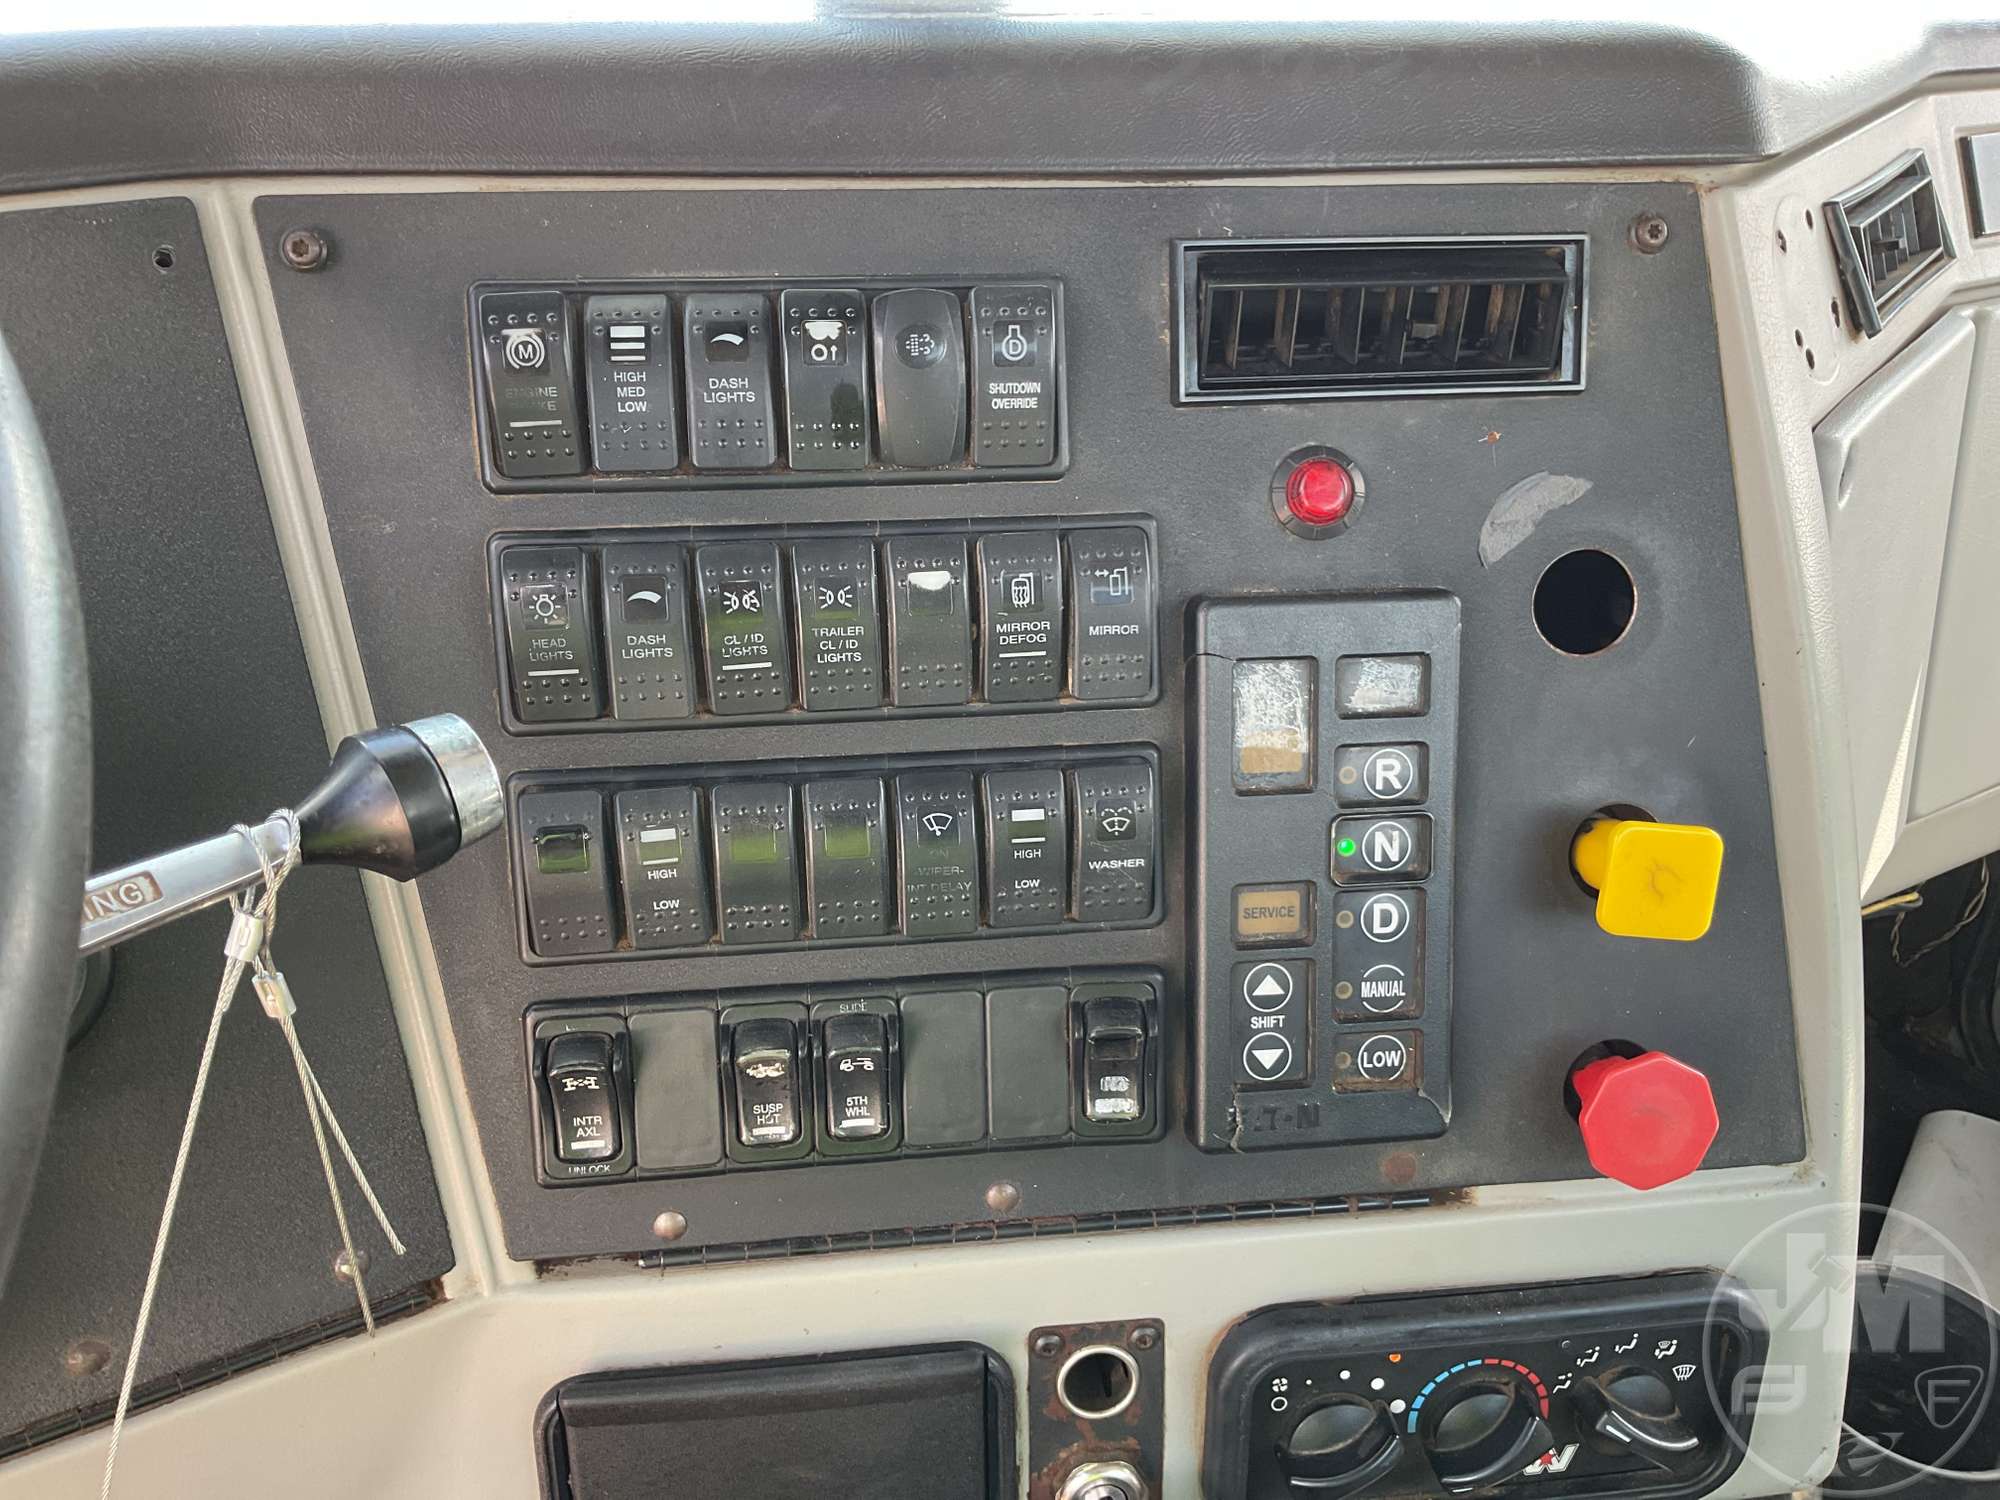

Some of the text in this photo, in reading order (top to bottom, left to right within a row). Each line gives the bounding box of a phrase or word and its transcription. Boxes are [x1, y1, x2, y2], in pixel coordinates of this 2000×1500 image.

[614, 372, 646, 383] HIGH
[709, 378, 749, 389] DASH
[617, 387, 646, 398] MED
[989, 382, 1041, 395] SHUTDOWN
[703, 391, 756, 404] LIGHTS
[991, 397, 1038, 409] OVERRIDE
[617, 402, 648, 413] LOW
[811, 626, 865, 638] TRAILER
[996, 621, 1051, 633] MIRROR
[1089, 625, 1139, 636] MIRROR
[532, 639, 567, 649] HEAD
[627, 634, 666, 646] DASH
[999, 633, 1047, 645] DEFOG
[529, 650, 574, 662] LIGHTS
[622, 648, 673, 659] LIGHTS
[722, 646, 769, 658] LIGHTS
[816, 652, 862, 664] LIGHTS
[1375, 758, 1401, 790] R
[1374, 831, 1400, 862] N
[1013, 849, 1042, 859] HIGH
[1088, 858, 1145, 870] WASHER
[647, 869, 677, 880] HIGH
[1014, 879, 1040, 889] LOW
[653, 899, 680, 911] LOW
[1243, 906, 1296, 919] SERVICE
[1373, 903, 1399, 934] D
[1361, 979, 1406, 998] MANUAL
[1250, 1015, 1286, 1029] SHIFT
[1363, 1049, 1401, 1068] LOW
[846, 1096, 868, 1106] 5TH
[753, 1103, 784, 1114] SUSP
[845, 1106, 870, 1117] WHL
[573, 1116, 602, 1127] INTR
[576, 1127, 601, 1138] AXL
[568, 1164, 611, 1175] UNLOCK
